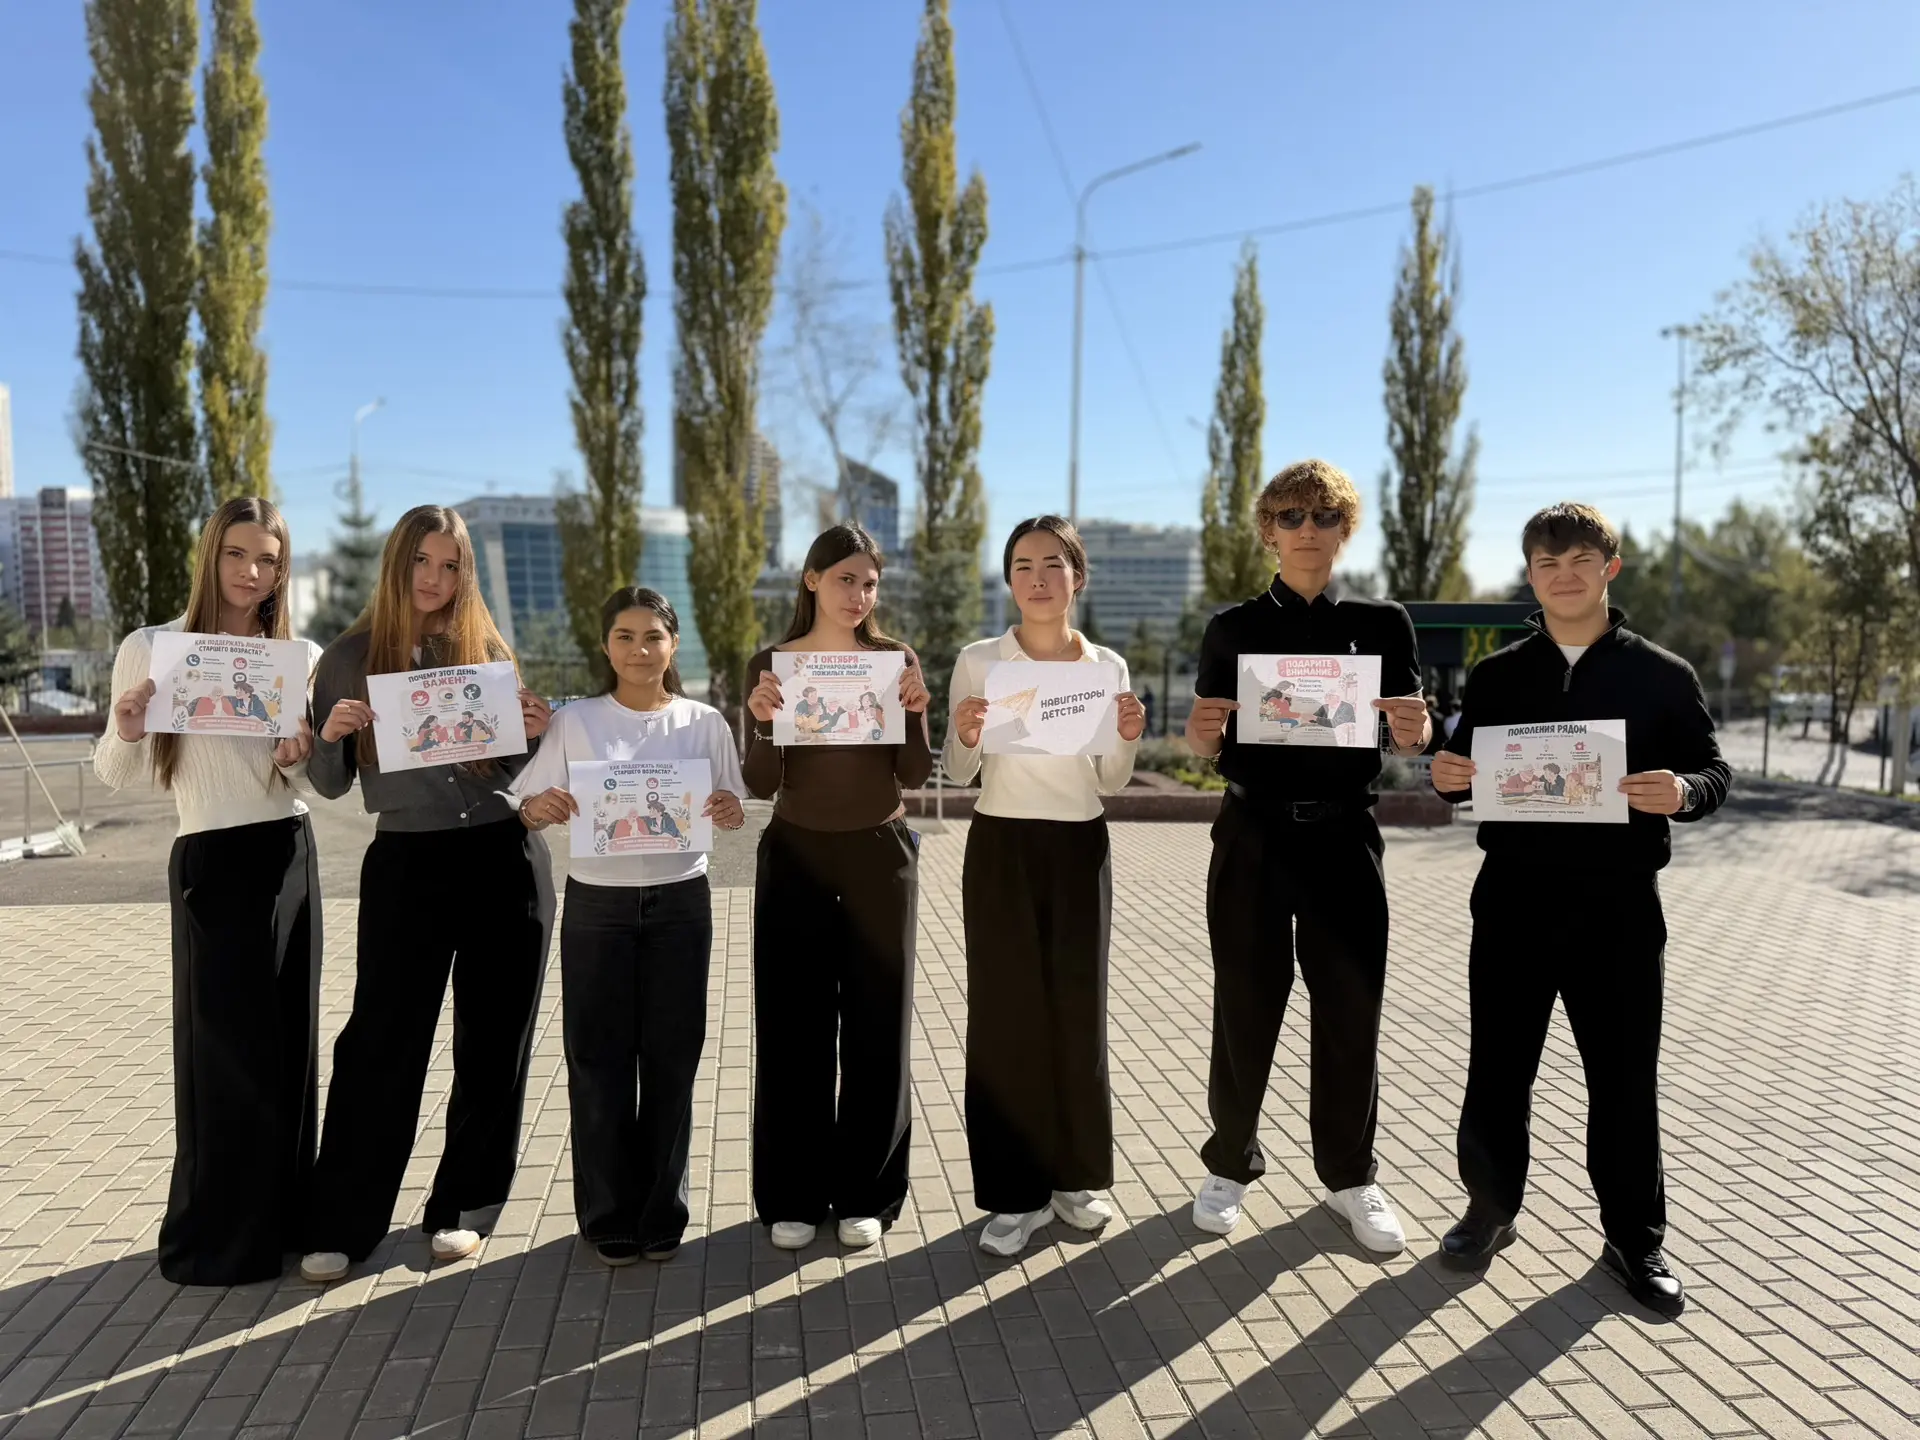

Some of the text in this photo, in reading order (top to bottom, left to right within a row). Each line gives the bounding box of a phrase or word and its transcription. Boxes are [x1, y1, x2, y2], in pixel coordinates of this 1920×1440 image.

[207, 640, 245, 648] ПОДДЕРЖАТЬ
[245, 642, 266, 650] ЛЮДЕЙ
[229, 647, 263, 656] ВОЗРАСТА?
[813, 655, 818, 664] 1
[821, 655, 859, 664] ОКТЯБРЯ
[1285, 659, 1332, 668] ПОДАРИТЕ
[408, 668, 478, 683] ПОЧЕМУ ЭТОТ ДЕНЬ
[1285, 667, 1333, 677] ВНИМАНИЕ
[422, 676, 467, 689] ВАЖЕН?
[1040, 689, 1106, 709] НАВИГАТОРЫ
[1041, 704, 1086, 721] ДЕТСТВА
[1508, 725, 1555, 737] ПОКОЛЕНИЯ
[1557, 724, 1588, 734] РЯДОМ
